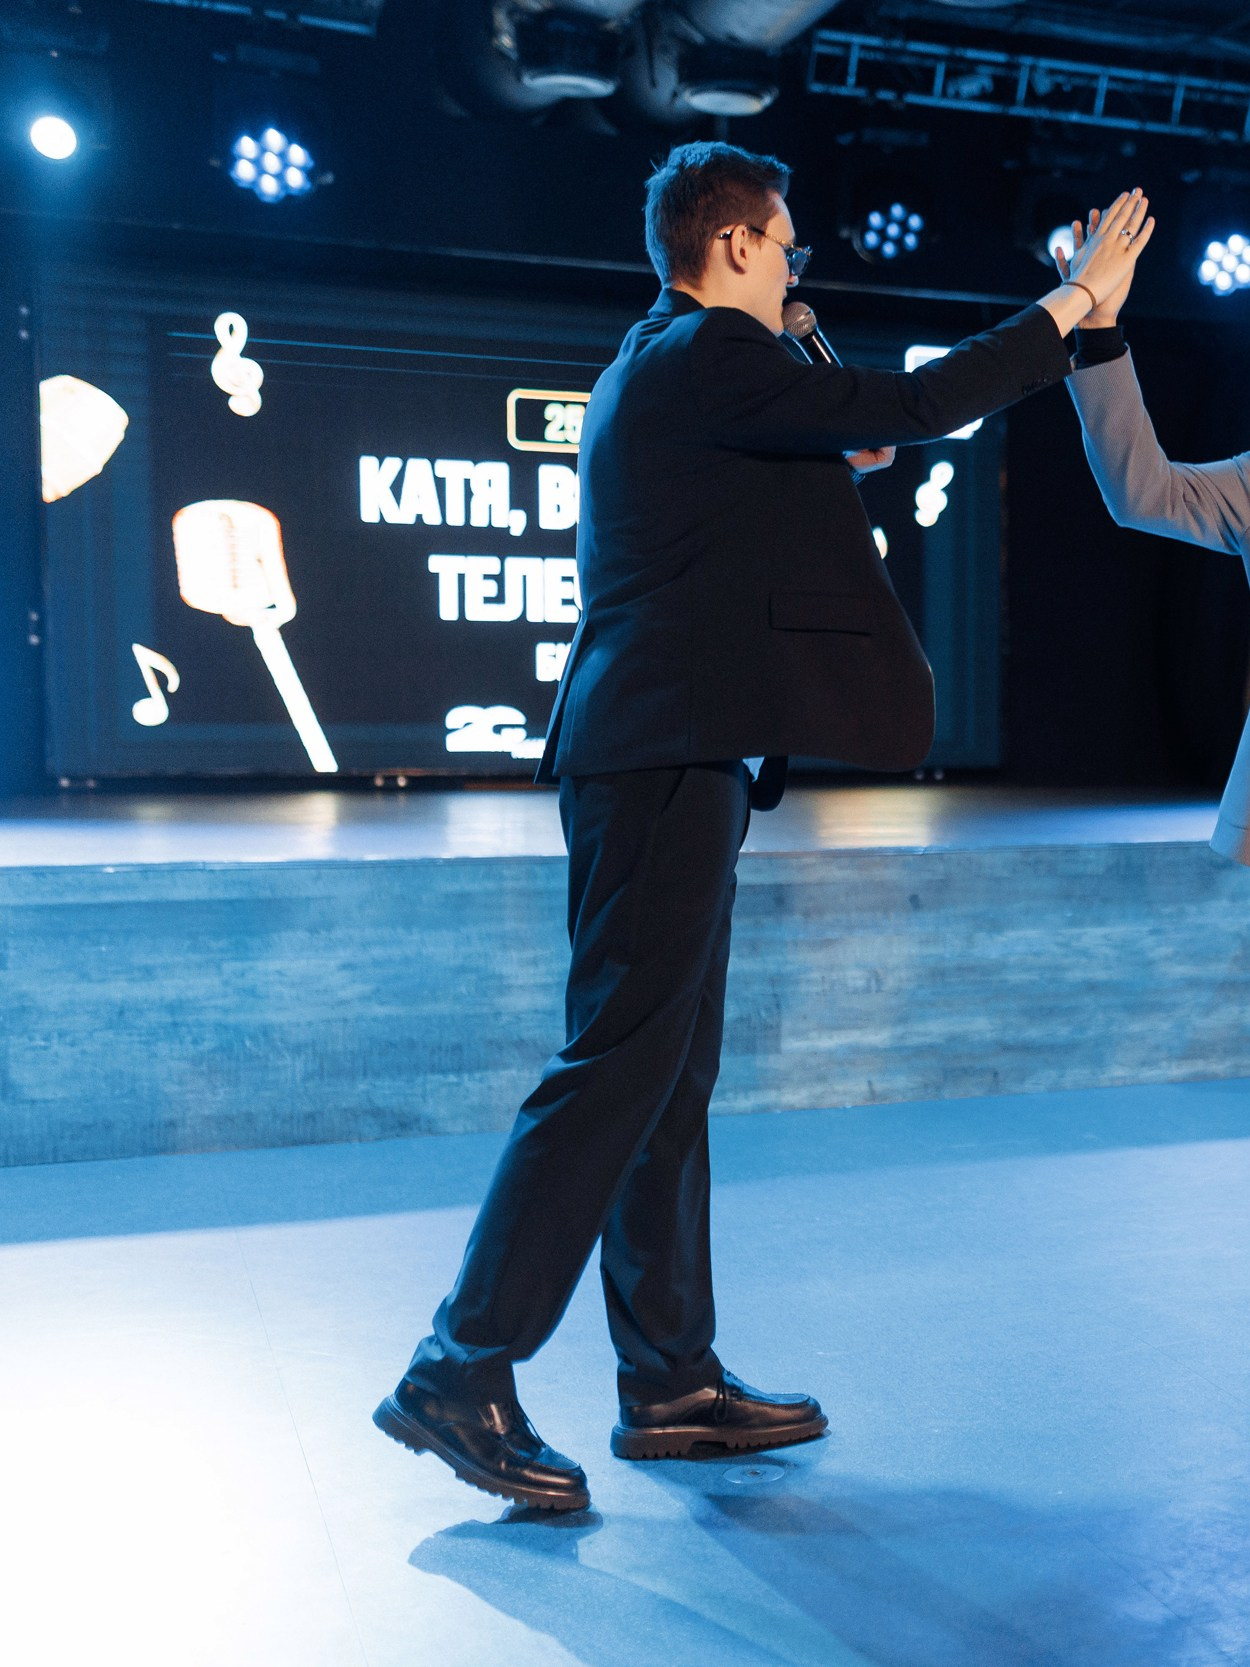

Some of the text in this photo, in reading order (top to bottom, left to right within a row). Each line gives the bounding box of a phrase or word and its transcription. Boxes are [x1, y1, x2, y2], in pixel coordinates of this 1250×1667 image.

[359, 455, 580, 536] КАТЯ, В
[428, 553, 583, 623] ТЕЛЕ
